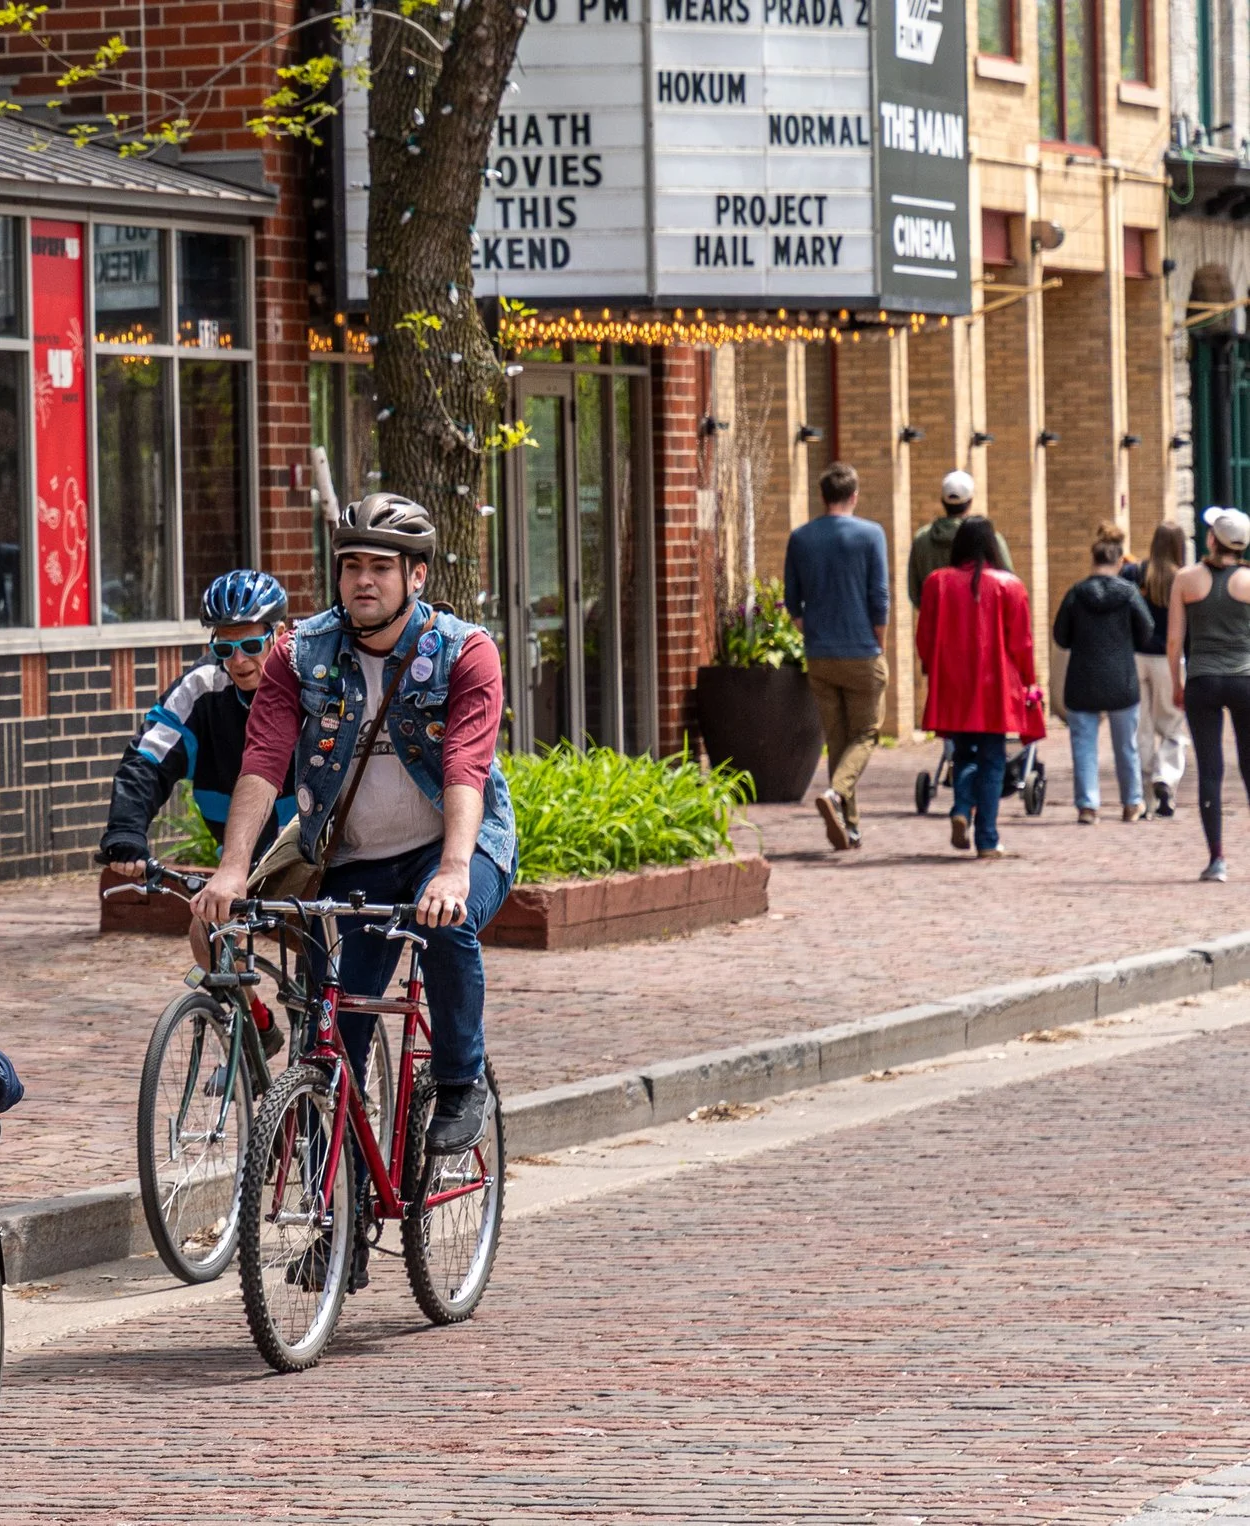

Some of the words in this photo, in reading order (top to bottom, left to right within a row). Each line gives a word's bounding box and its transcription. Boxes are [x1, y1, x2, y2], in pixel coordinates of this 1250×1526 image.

[579, 0, 629, 23] PM
[665, 0, 750, 23] WEARS
[764, 0, 844, 27] PRADA
[855, 0, 869, 28] 2
[899, 24, 924, 52] FILM
[658, 71, 746, 104] HOKUM
[498, 112, 591, 147] HATH
[768, 114, 870, 147] NORMAL
[880, 101, 916, 153] THE
[917, 107, 964, 160] MAIN
[484, 153, 603, 189] OVIES
[495, 195, 577, 230] THIS
[715, 194, 828, 227] PROJECT
[694, 234, 755, 268] HAIL
[773, 234, 843, 268] MARY
[892, 213, 956, 262] CINEMA
[46, 348, 74, 389] 45
